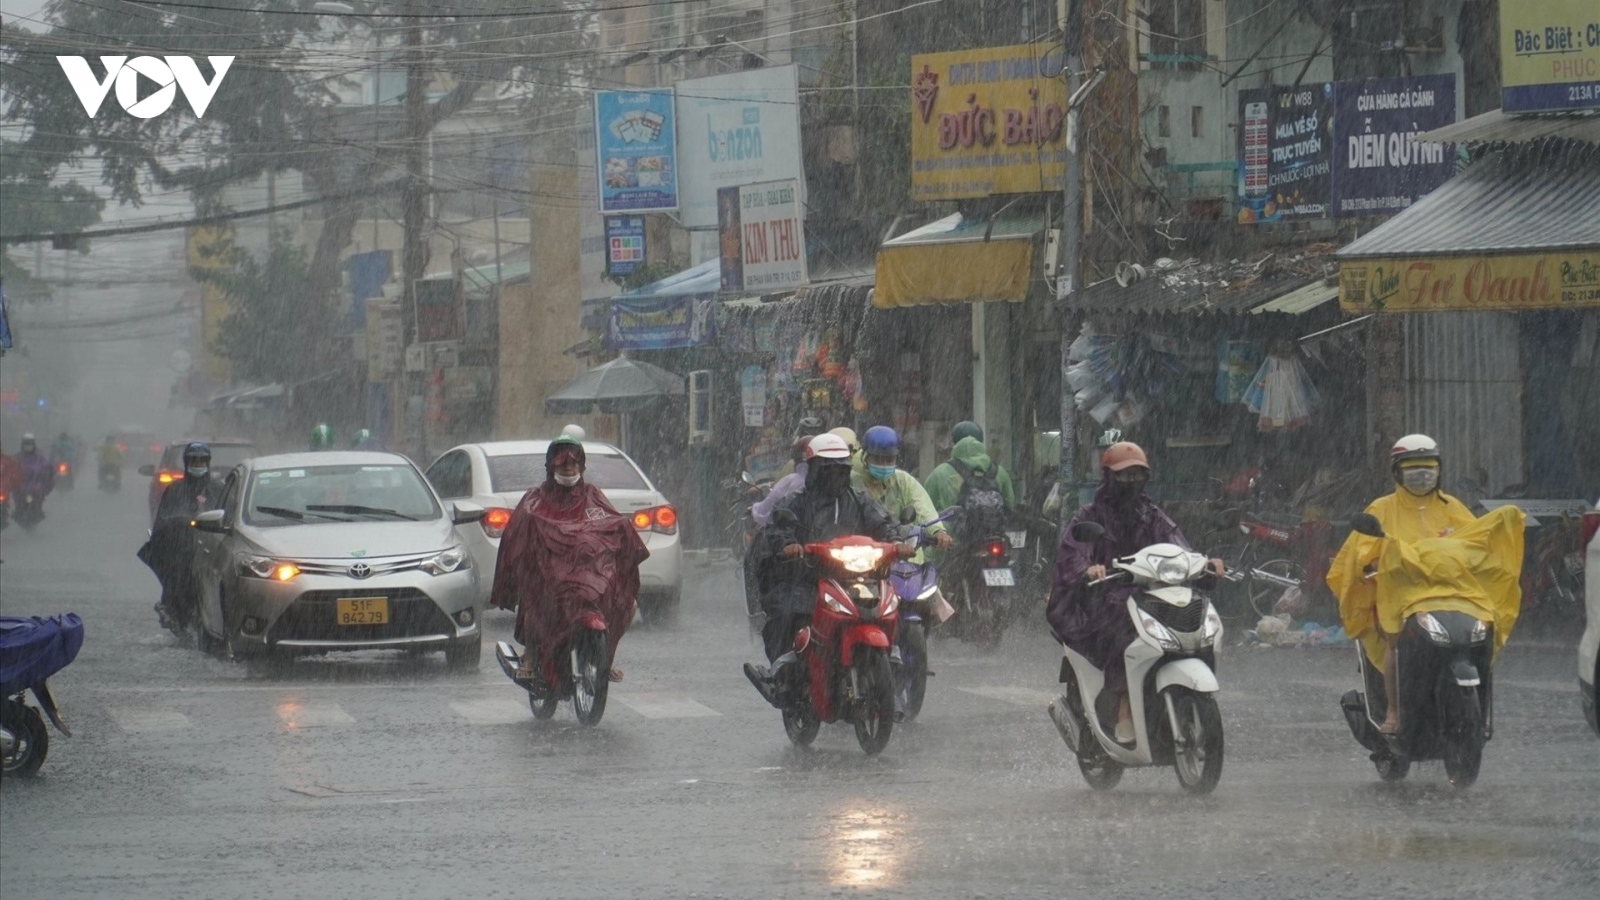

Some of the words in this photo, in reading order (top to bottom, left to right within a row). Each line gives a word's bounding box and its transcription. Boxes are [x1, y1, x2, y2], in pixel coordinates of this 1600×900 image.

[1515, 29, 1541, 57] Đặc
[1545, 26, 1572, 54] Biệt
[617, 95, 651, 104] bnzon
[1294, 91, 1312, 107] W88
[1357, 89, 1375, 111] CỬA
[1376, 90, 1398, 109] HÀNG
[1399, 88, 1411, 108] CÁ
[1411, 85, 1435, 107] CẢNH
[1568, 86, 1592, 101] 213A
[937, 92, 995, 150] ĐỨC
[1275, 125, 1294, 140] MUA
[1295, 115, 1307, 135] VÉ
[1306, 109, 1319, 132] SỐ
[1294, 132, 1322, 156] TUYẾN
[1348, 118, 1386, 169] DIỄM
[1314, 160, 1330, 177] NHÀ
[743, 222, 769, 264] KIM
[769, 218, 801, 261] THU
[1463, 258, 1555, 304] Oanh
[343, 612, 383, 623] 842.79
[351, 601, 373, 611] 51F
